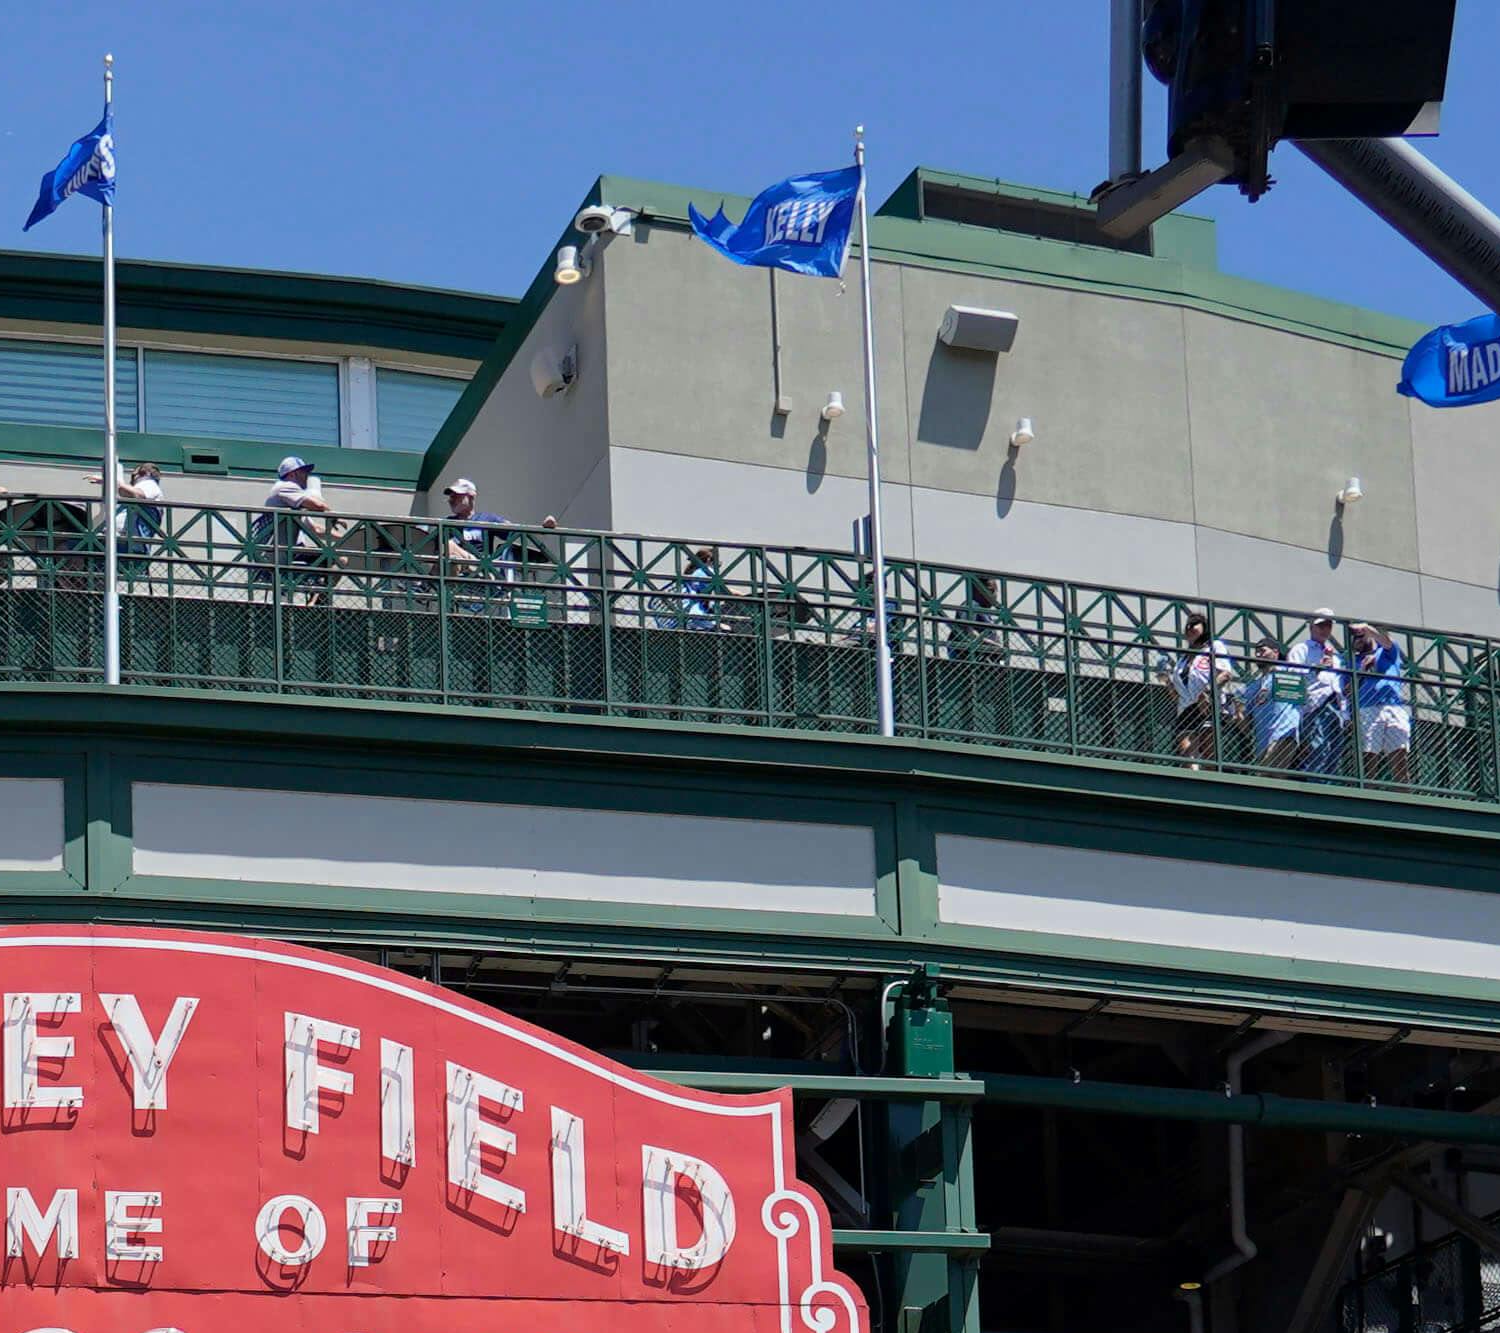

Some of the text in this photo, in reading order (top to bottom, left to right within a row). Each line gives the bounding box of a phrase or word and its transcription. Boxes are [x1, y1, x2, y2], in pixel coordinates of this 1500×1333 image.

[764, 198, 837, 246] KELLY
[284, 1011, 737, 1270] FIELD
[254, 1194, 402, 1267] OF
